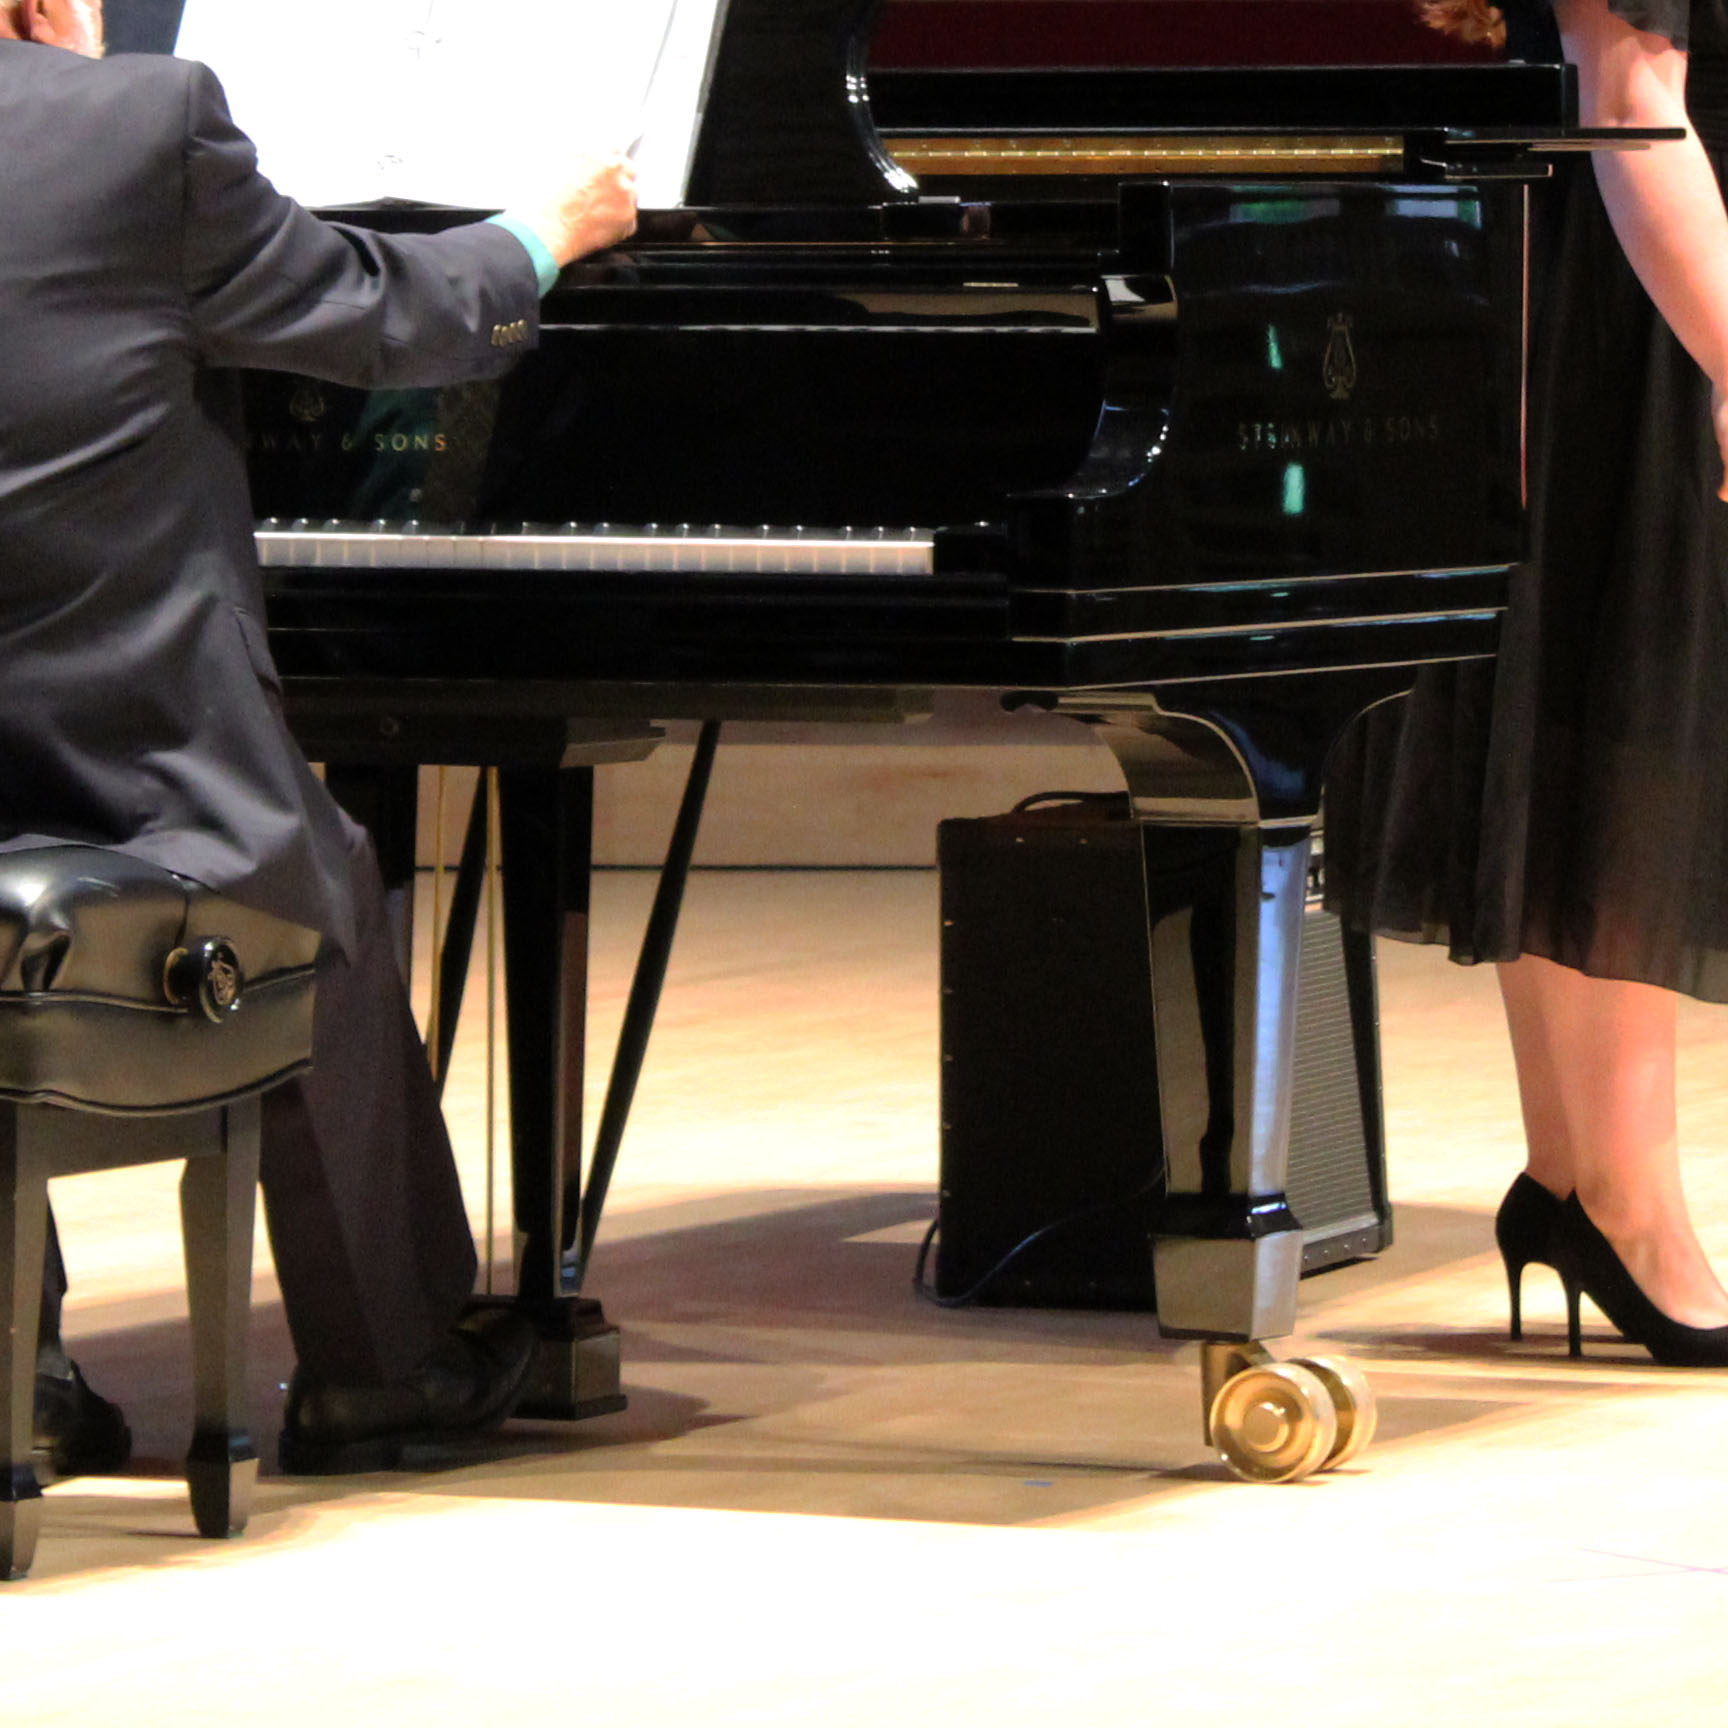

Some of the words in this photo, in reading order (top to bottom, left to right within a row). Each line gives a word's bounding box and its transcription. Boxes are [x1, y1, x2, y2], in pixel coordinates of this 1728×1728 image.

[340, 432, 354, 452] &
[374, 432, 449, 452] SONS
[1239, 419, 1352, 450] STEINWAY
[1385, 415, 1439, 442] SONS
